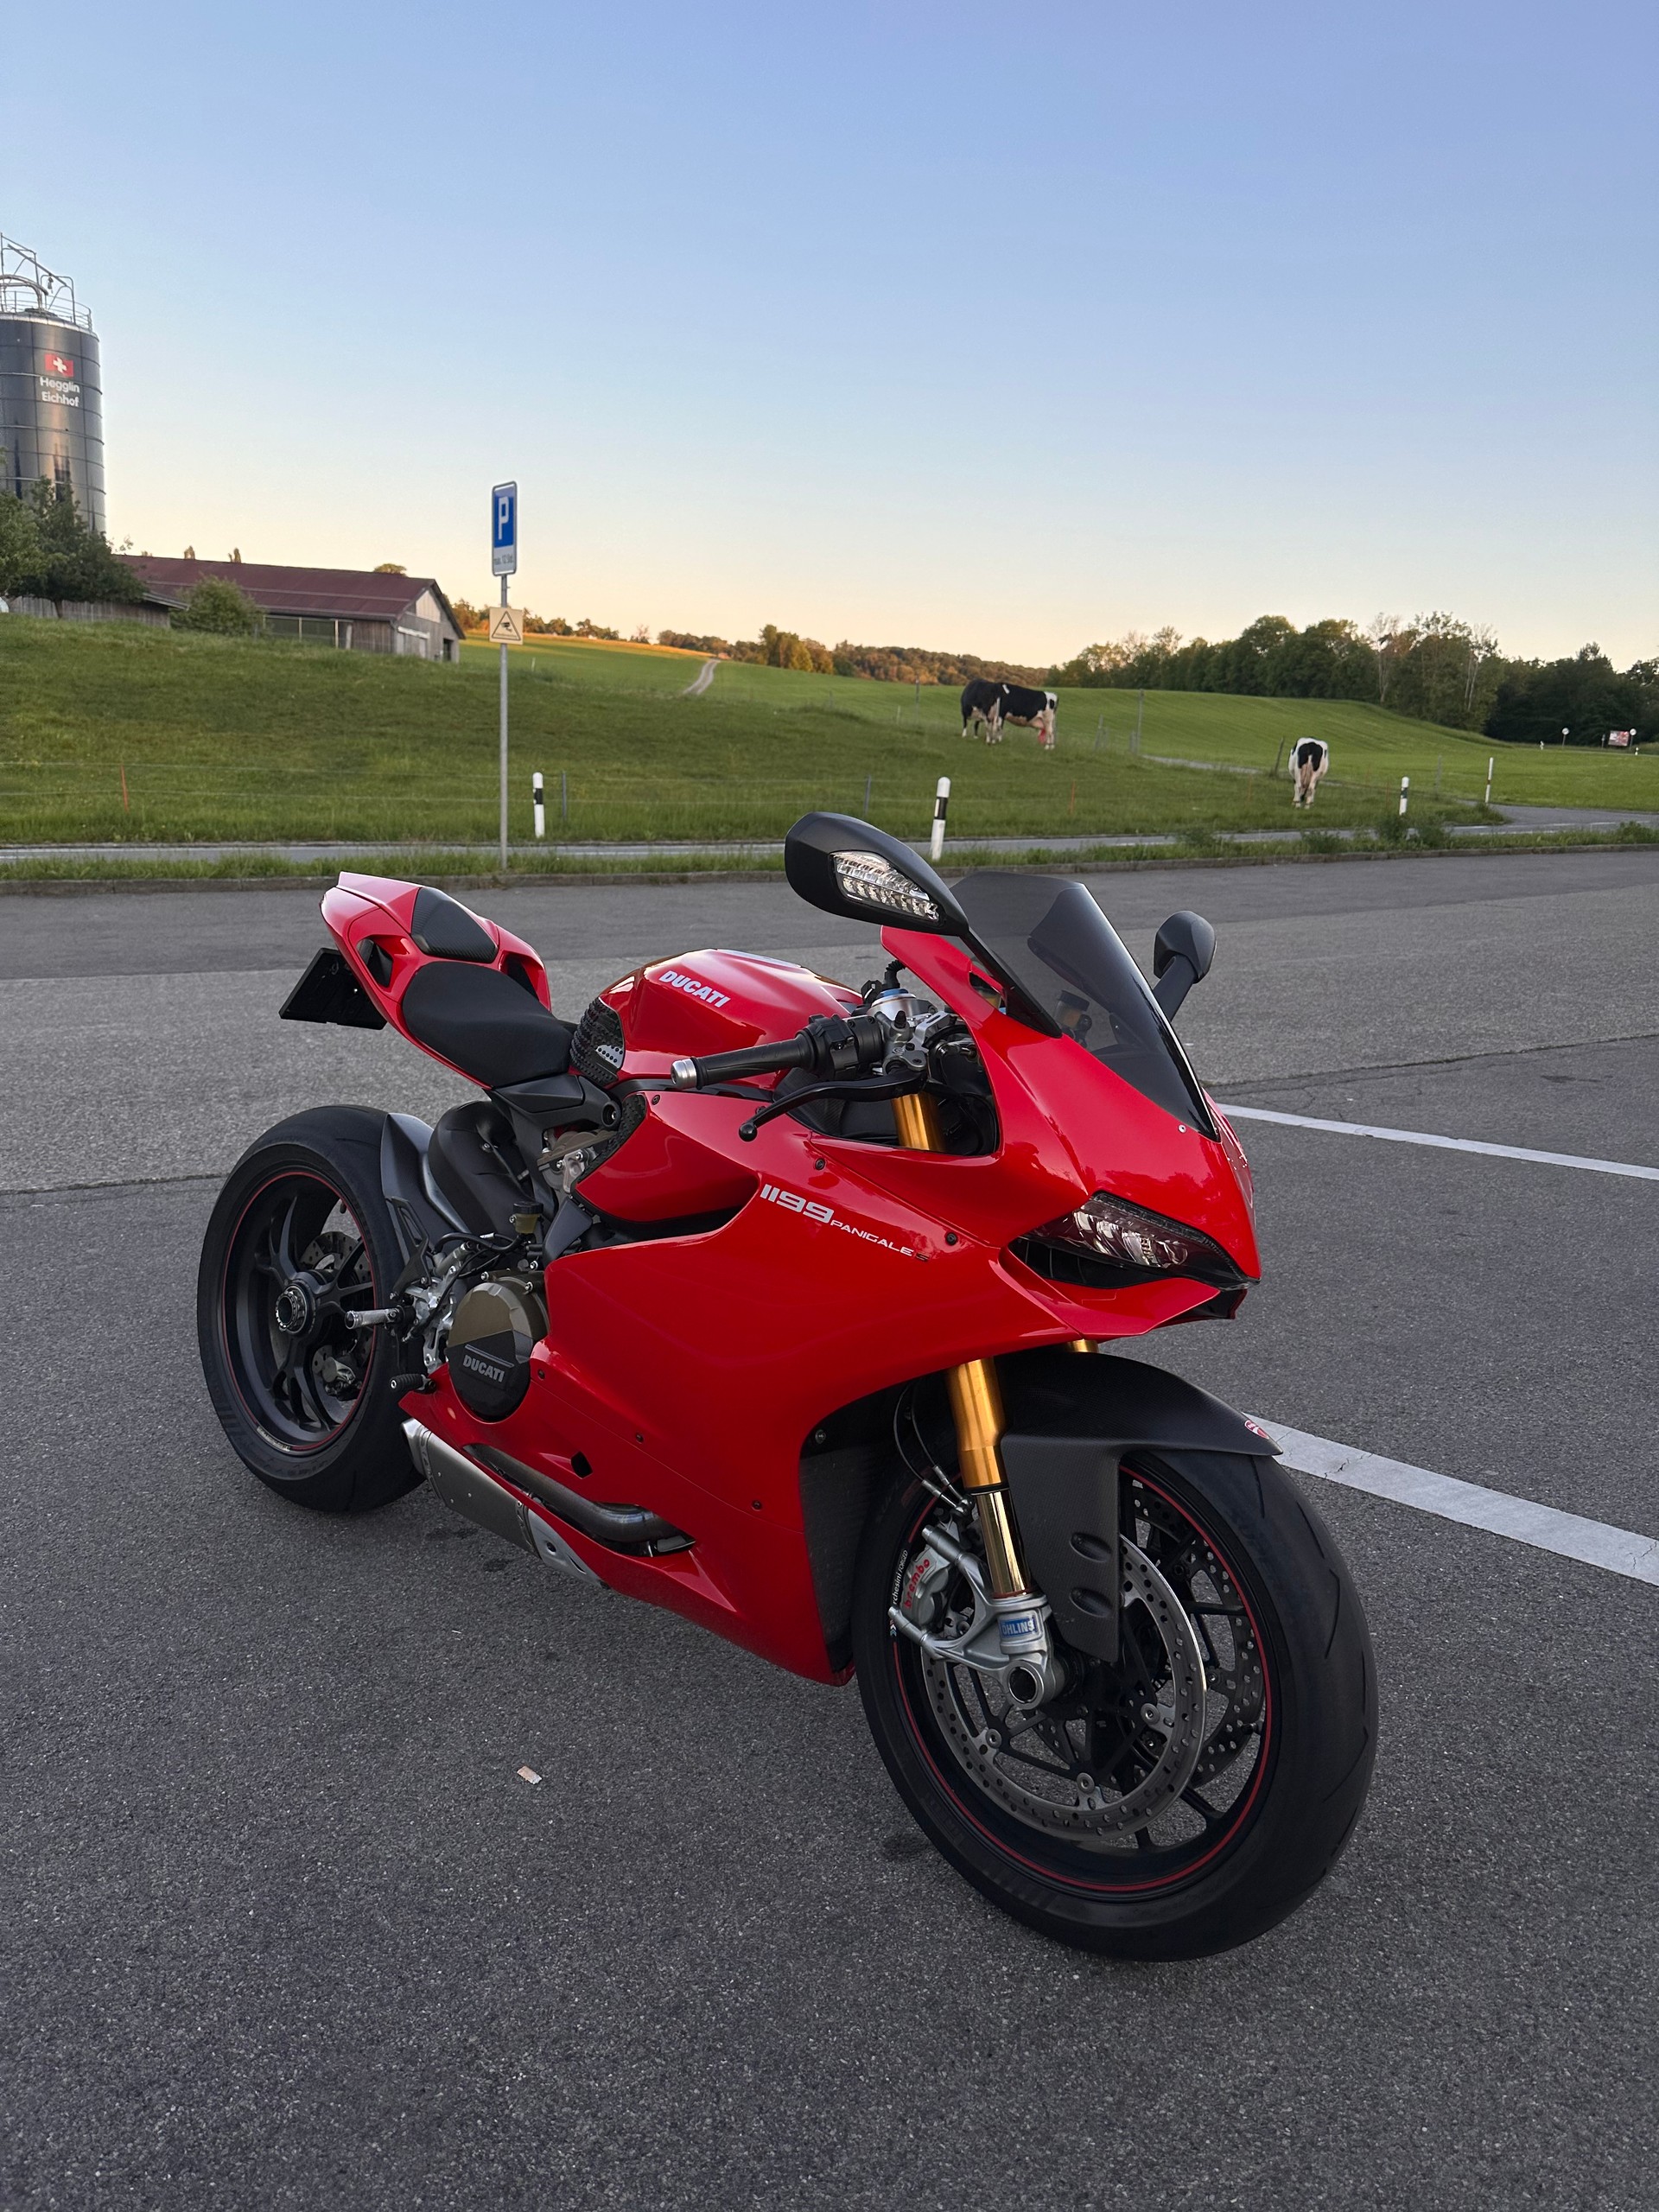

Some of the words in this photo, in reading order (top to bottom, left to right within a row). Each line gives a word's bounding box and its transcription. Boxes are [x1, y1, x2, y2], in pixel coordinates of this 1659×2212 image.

[41, 391, 79, 407] Eichhof
[499, 496, 509, 540] P
[658, 970, 731, 1007] DUCATI
[760, 1184, 835, 1224] 1199
[830, 1219, 914, 1256] PANIGALE
[462, 1354, 505, 1382] DUCATI
[892, 1570, 903, 1605] rchesini
[904, 1558, 931, 1609] brembo
